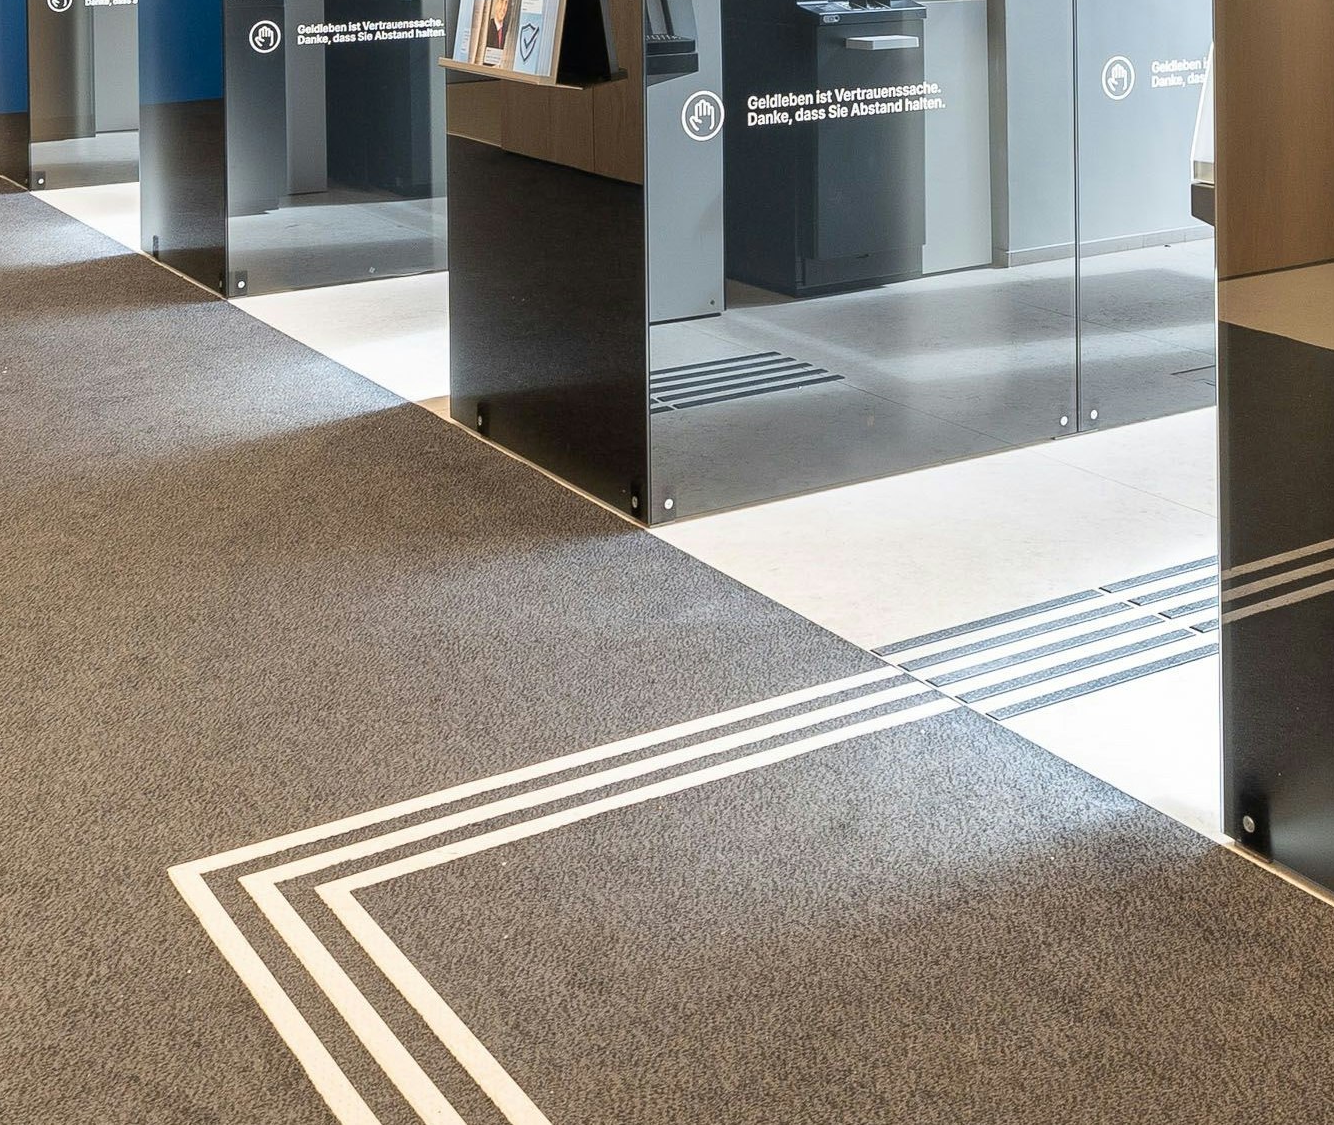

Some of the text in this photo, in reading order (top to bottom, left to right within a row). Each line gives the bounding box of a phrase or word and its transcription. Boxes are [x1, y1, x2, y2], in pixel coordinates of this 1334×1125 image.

[297, 18, 444, 34] Geldleben ist Vertrauenssache.
[297, 33, 331, 45] Danke,
[333, 34, 356, 43] dass
[357, 32, 372, 41] Sie
[374, 29, 414, 40] Abstand
[1151, 59, 1201, 73] Geldleben
[1151, 74, 1185, 87] Danke,
[747, 81, 941, 110] Geldleben ist Vertrauenssache.
[747, 97, 946, 126] Danke, dass Sie Abstand halten.
